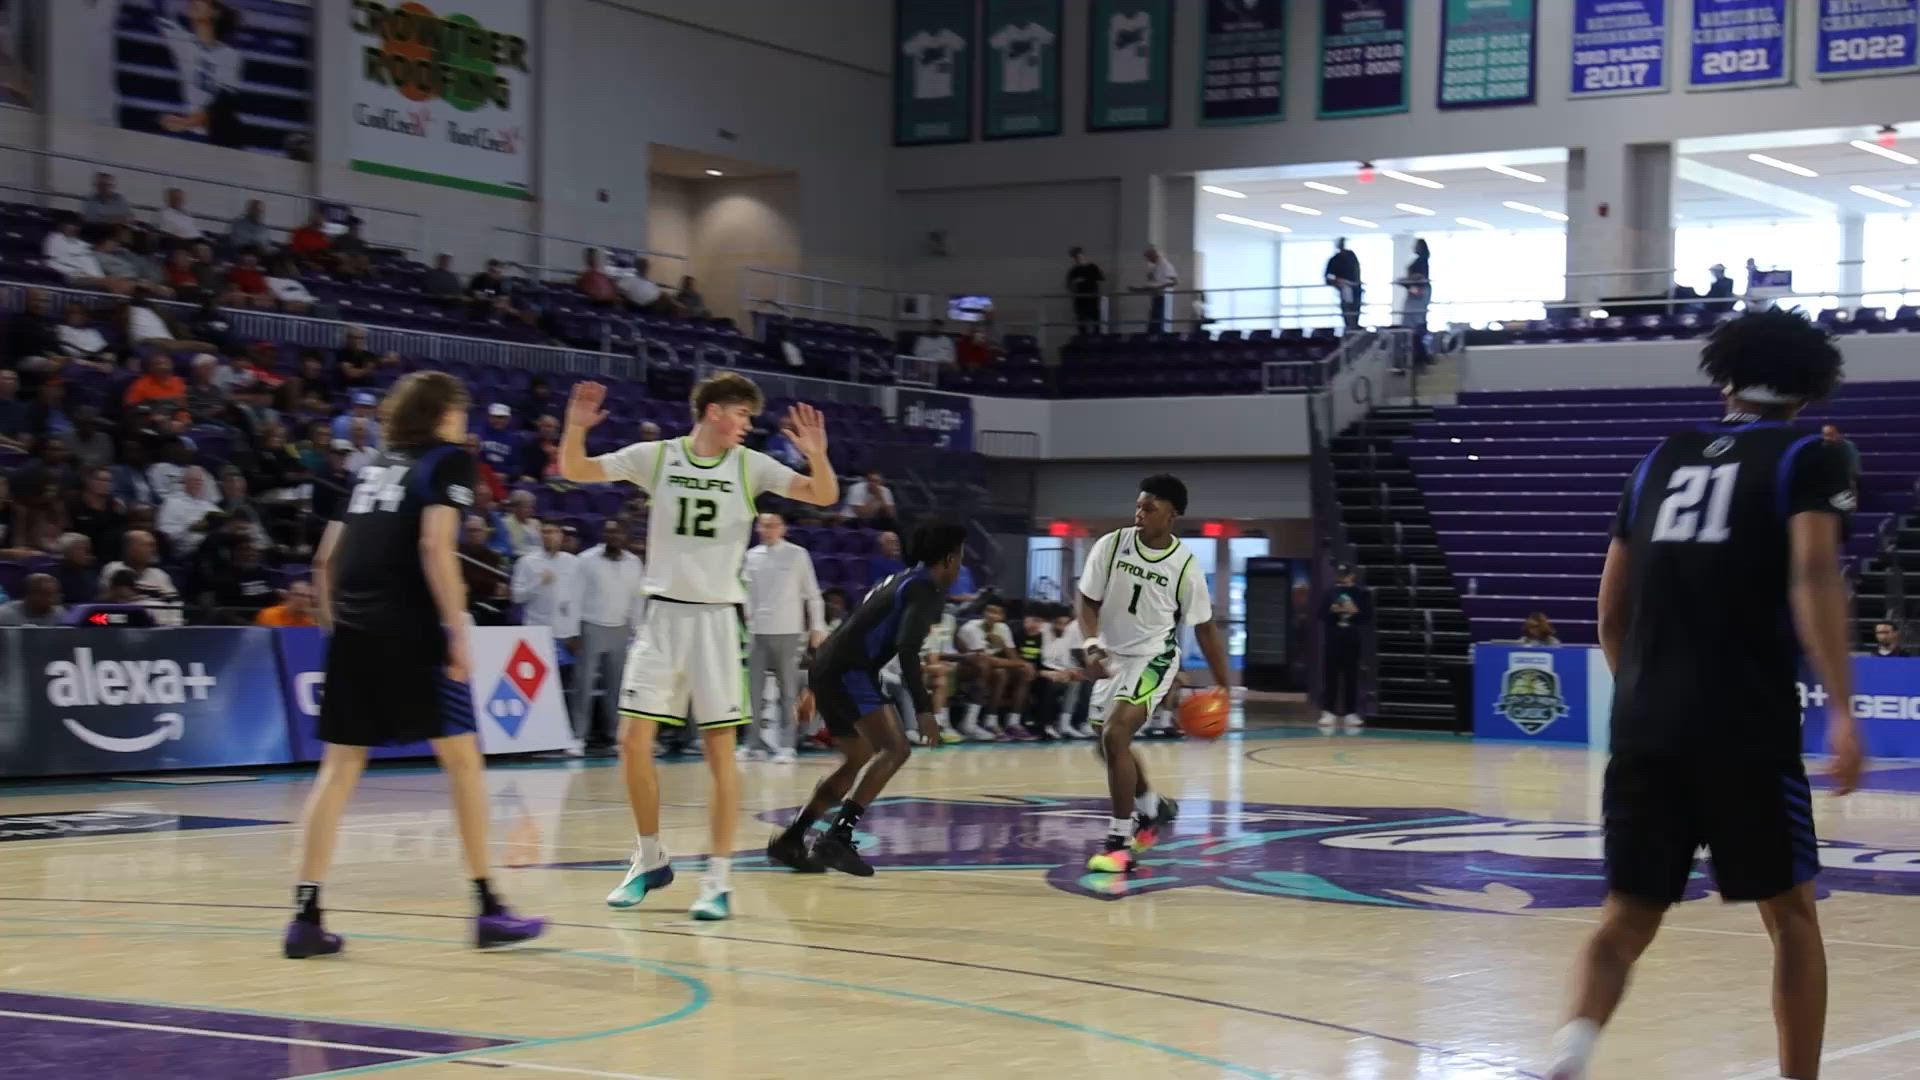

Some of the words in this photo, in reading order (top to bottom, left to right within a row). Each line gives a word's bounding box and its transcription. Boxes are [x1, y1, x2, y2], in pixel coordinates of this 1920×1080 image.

[1702, 48, 1770, 75] 2021
[1828, 34, 1905, 62] 2022
[1584, 62, 1650, 89] 2017
[674, 496, 717, 538] 12
[1651, 462, 1741, 542] 21
[1116, 560, 1169, 587] PROLIFIC
[1128, 583, 1142, 615] 1
[44, 646, 217, 706] alexa+
